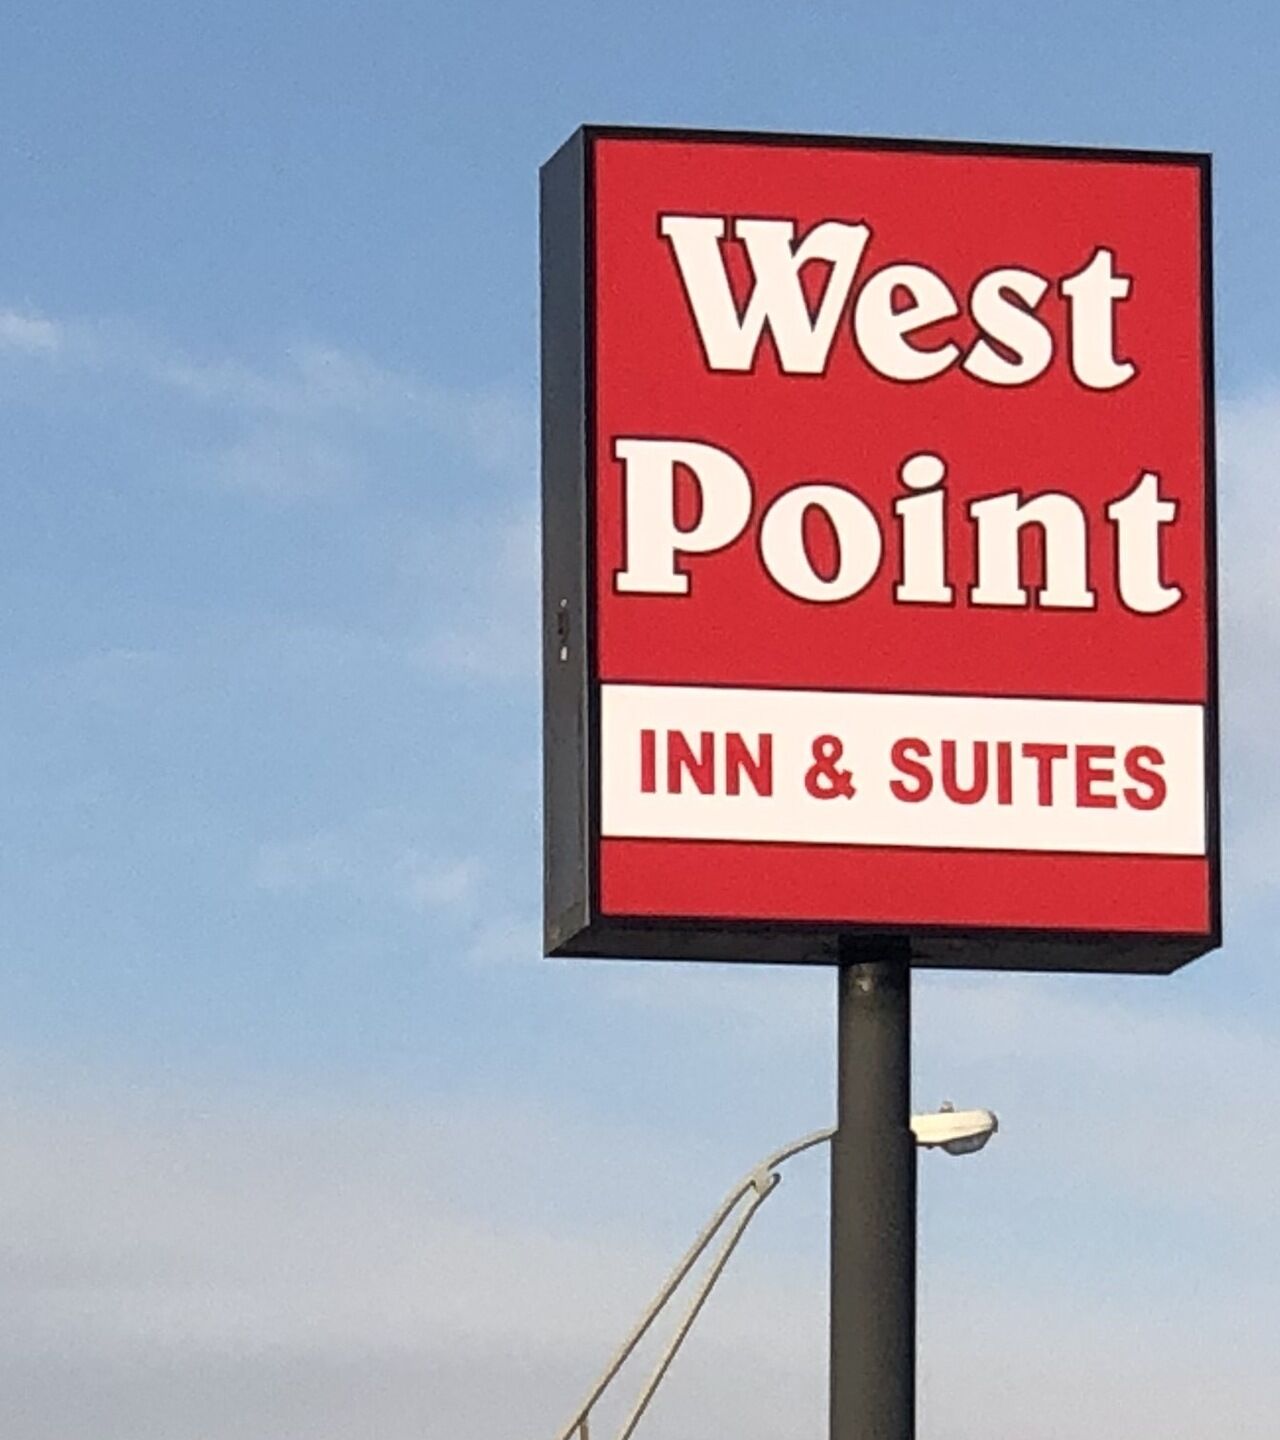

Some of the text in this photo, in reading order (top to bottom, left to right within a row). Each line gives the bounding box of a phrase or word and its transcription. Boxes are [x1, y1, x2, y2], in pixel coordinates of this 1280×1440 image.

[658, 212, 1138, 391] West
[612, 436, 1185, 615] Point
[640, 728, 1167, 811] INN & SUITES
